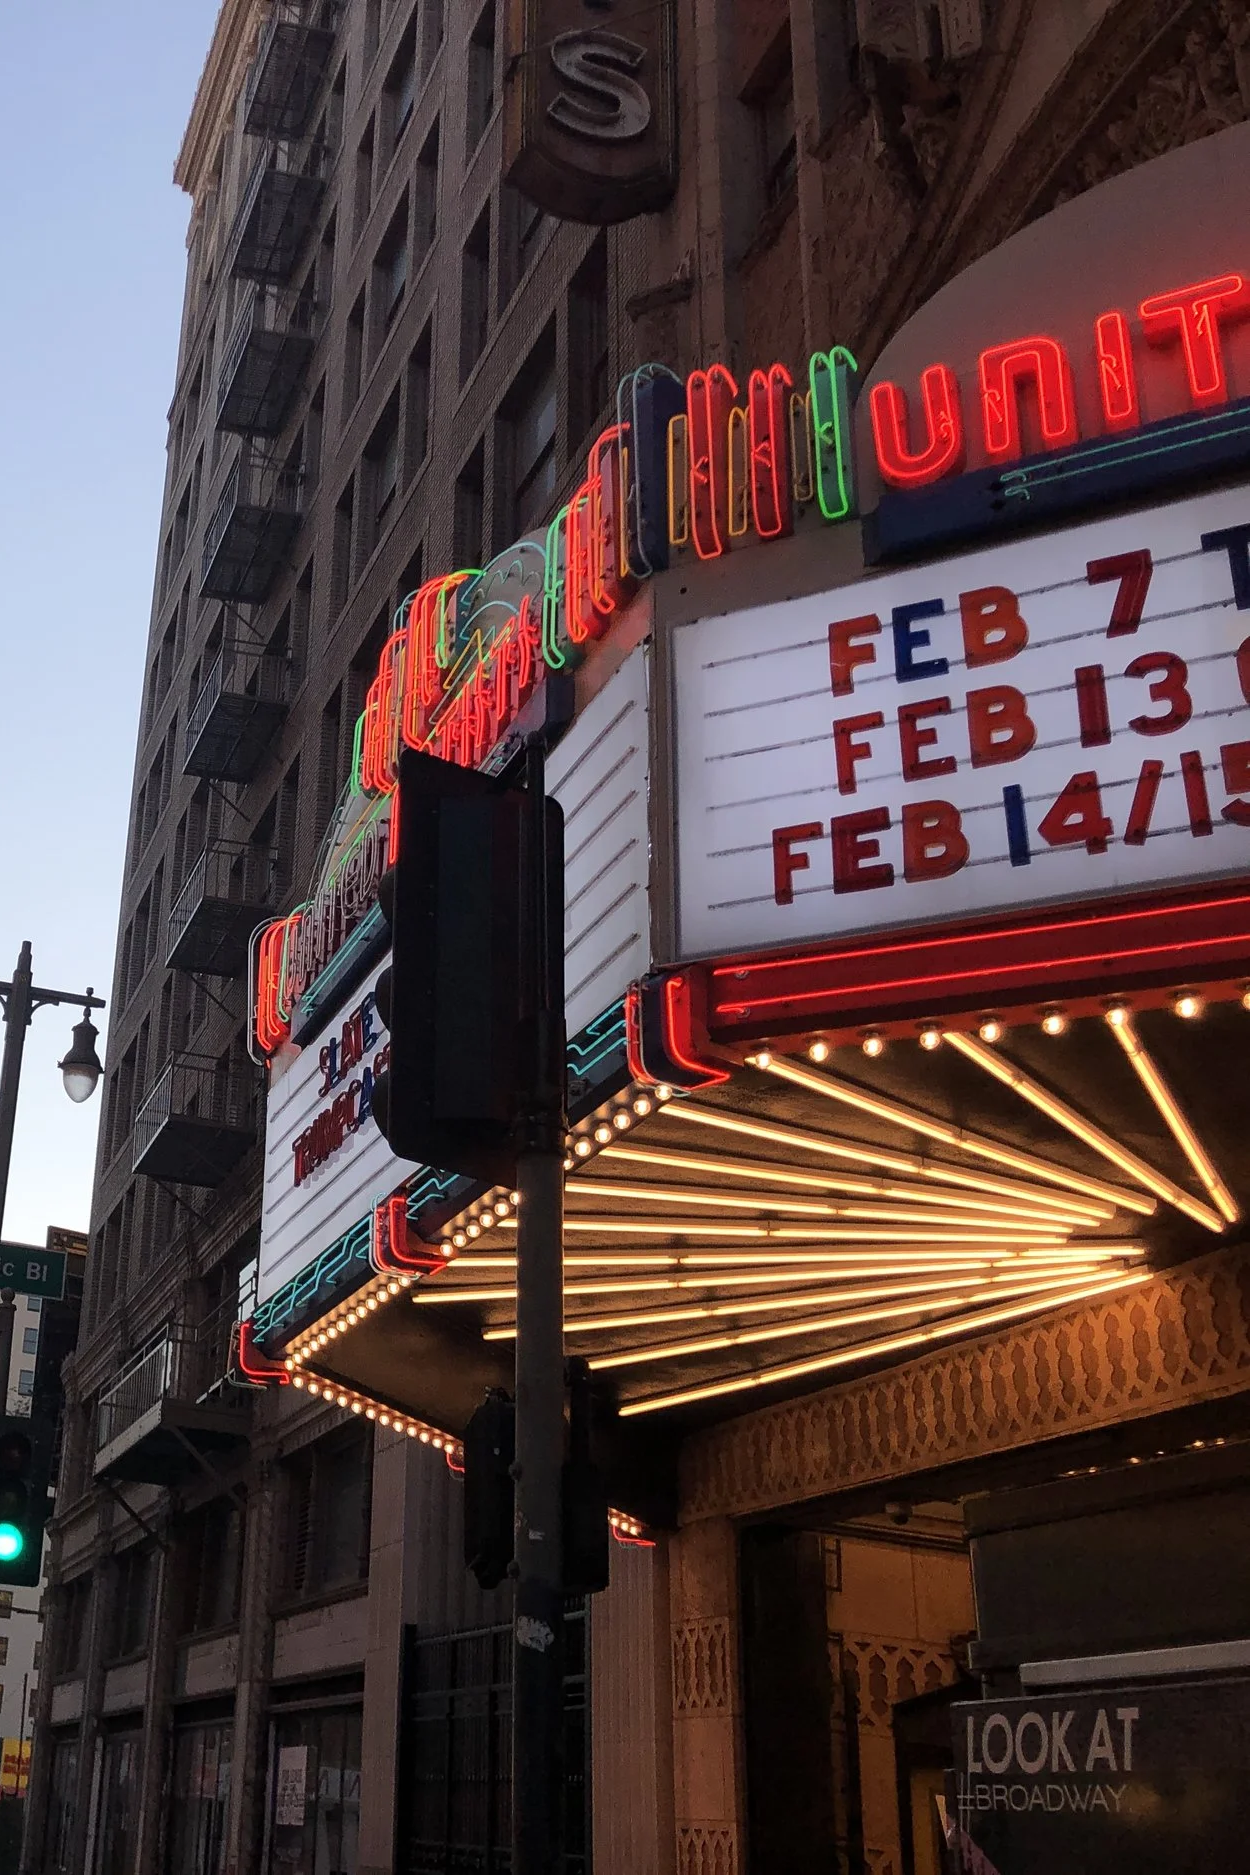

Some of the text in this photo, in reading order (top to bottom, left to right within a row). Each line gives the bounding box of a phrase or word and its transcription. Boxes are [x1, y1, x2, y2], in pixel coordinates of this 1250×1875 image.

[828, 586, 1029, 696] FEB
[1087, 549, 1153, 639] 7
[834, 685, 1038, 795] FEB
[1076, 651, 1193, 748] 13
[772, 799, 970, 906] FEB
[318, 991, 378, 1098] SLATE
[26, 1261, 48, 1282] Bl
[966, 1706, 1141, 1775] LOOK AT
[956, 1774, 1127, 1826] #BROADWAY
